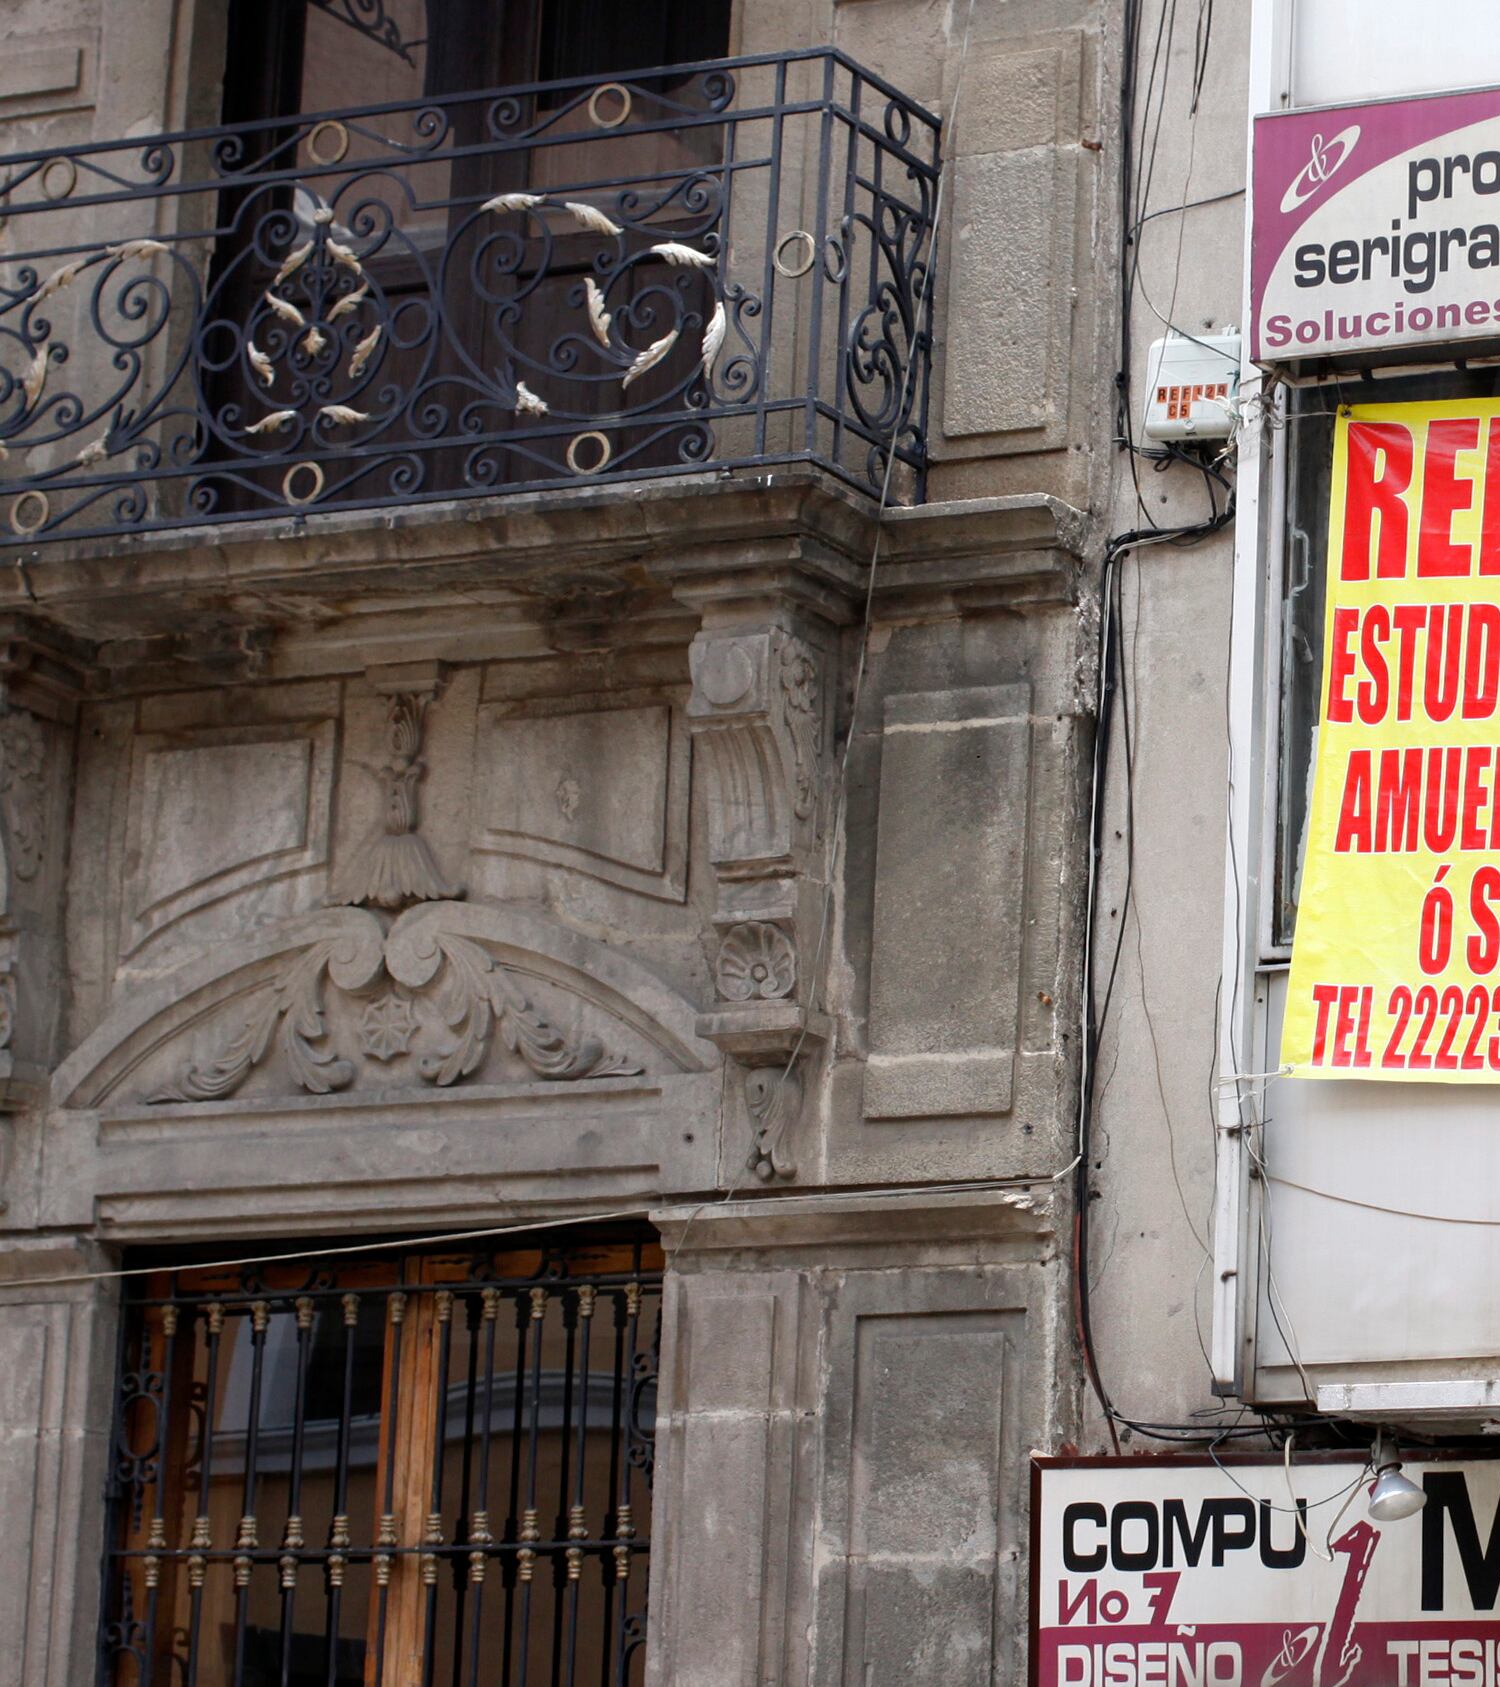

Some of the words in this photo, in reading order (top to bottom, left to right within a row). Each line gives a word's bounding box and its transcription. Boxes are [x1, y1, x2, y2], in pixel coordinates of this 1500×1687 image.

[1312, 984, 1374, 1067] TEL
[1063, 1498, 1308, 1573] COMPU
[1057, 1625, 1243, 1687] DISEÑO
